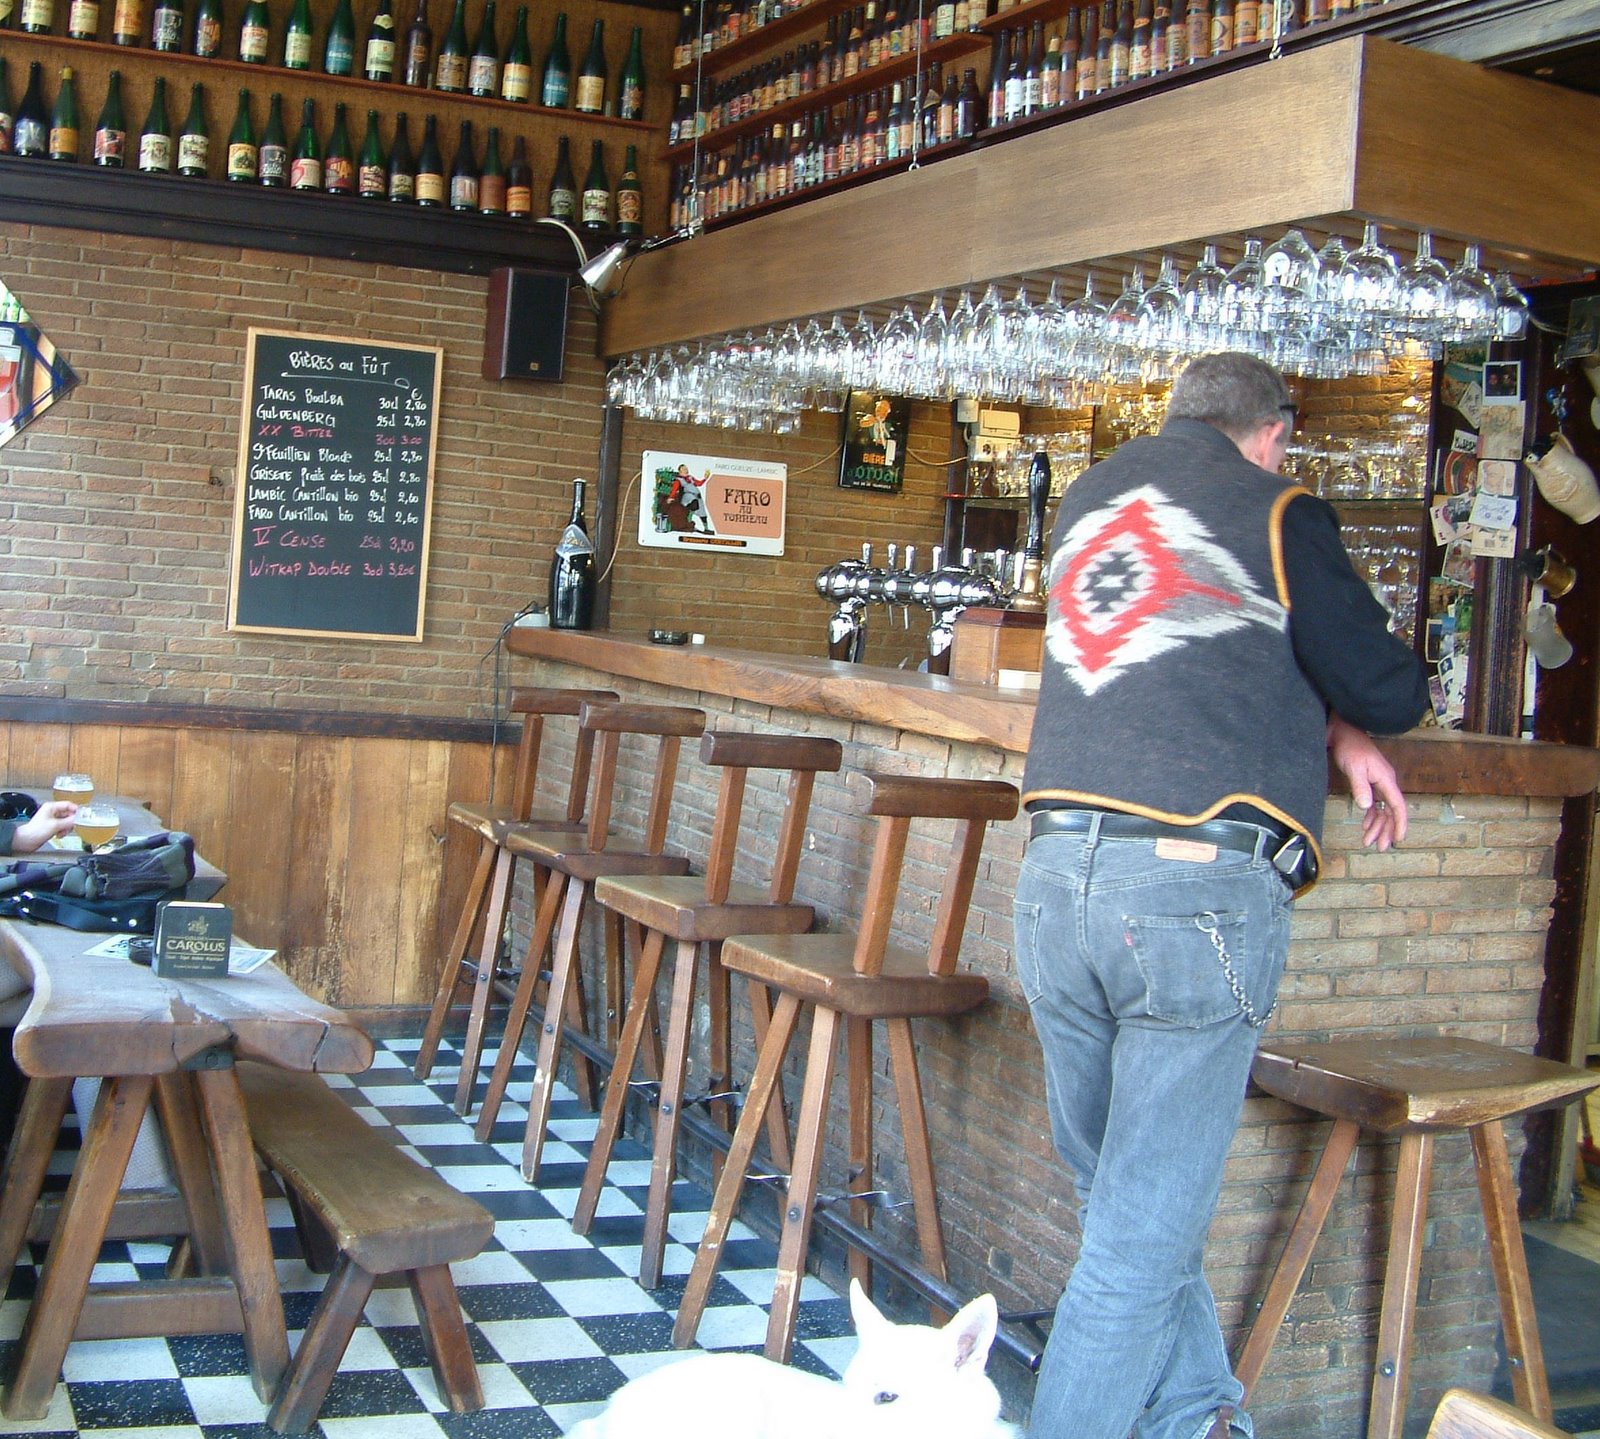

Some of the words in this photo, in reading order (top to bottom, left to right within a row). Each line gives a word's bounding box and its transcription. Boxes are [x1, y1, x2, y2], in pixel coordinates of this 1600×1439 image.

[261, 385, 296, 402] TARAS
[330, 469, 346, 482] des
[345, 488, 359, 502] bio
[724, 488, 771, 506] FARO
[248, 504, 273, 520] FARO
[338, 506, 354, 522] bio
[739, 505, 752, 514] AU
[166, 939, 225, 953] CAROLUS
